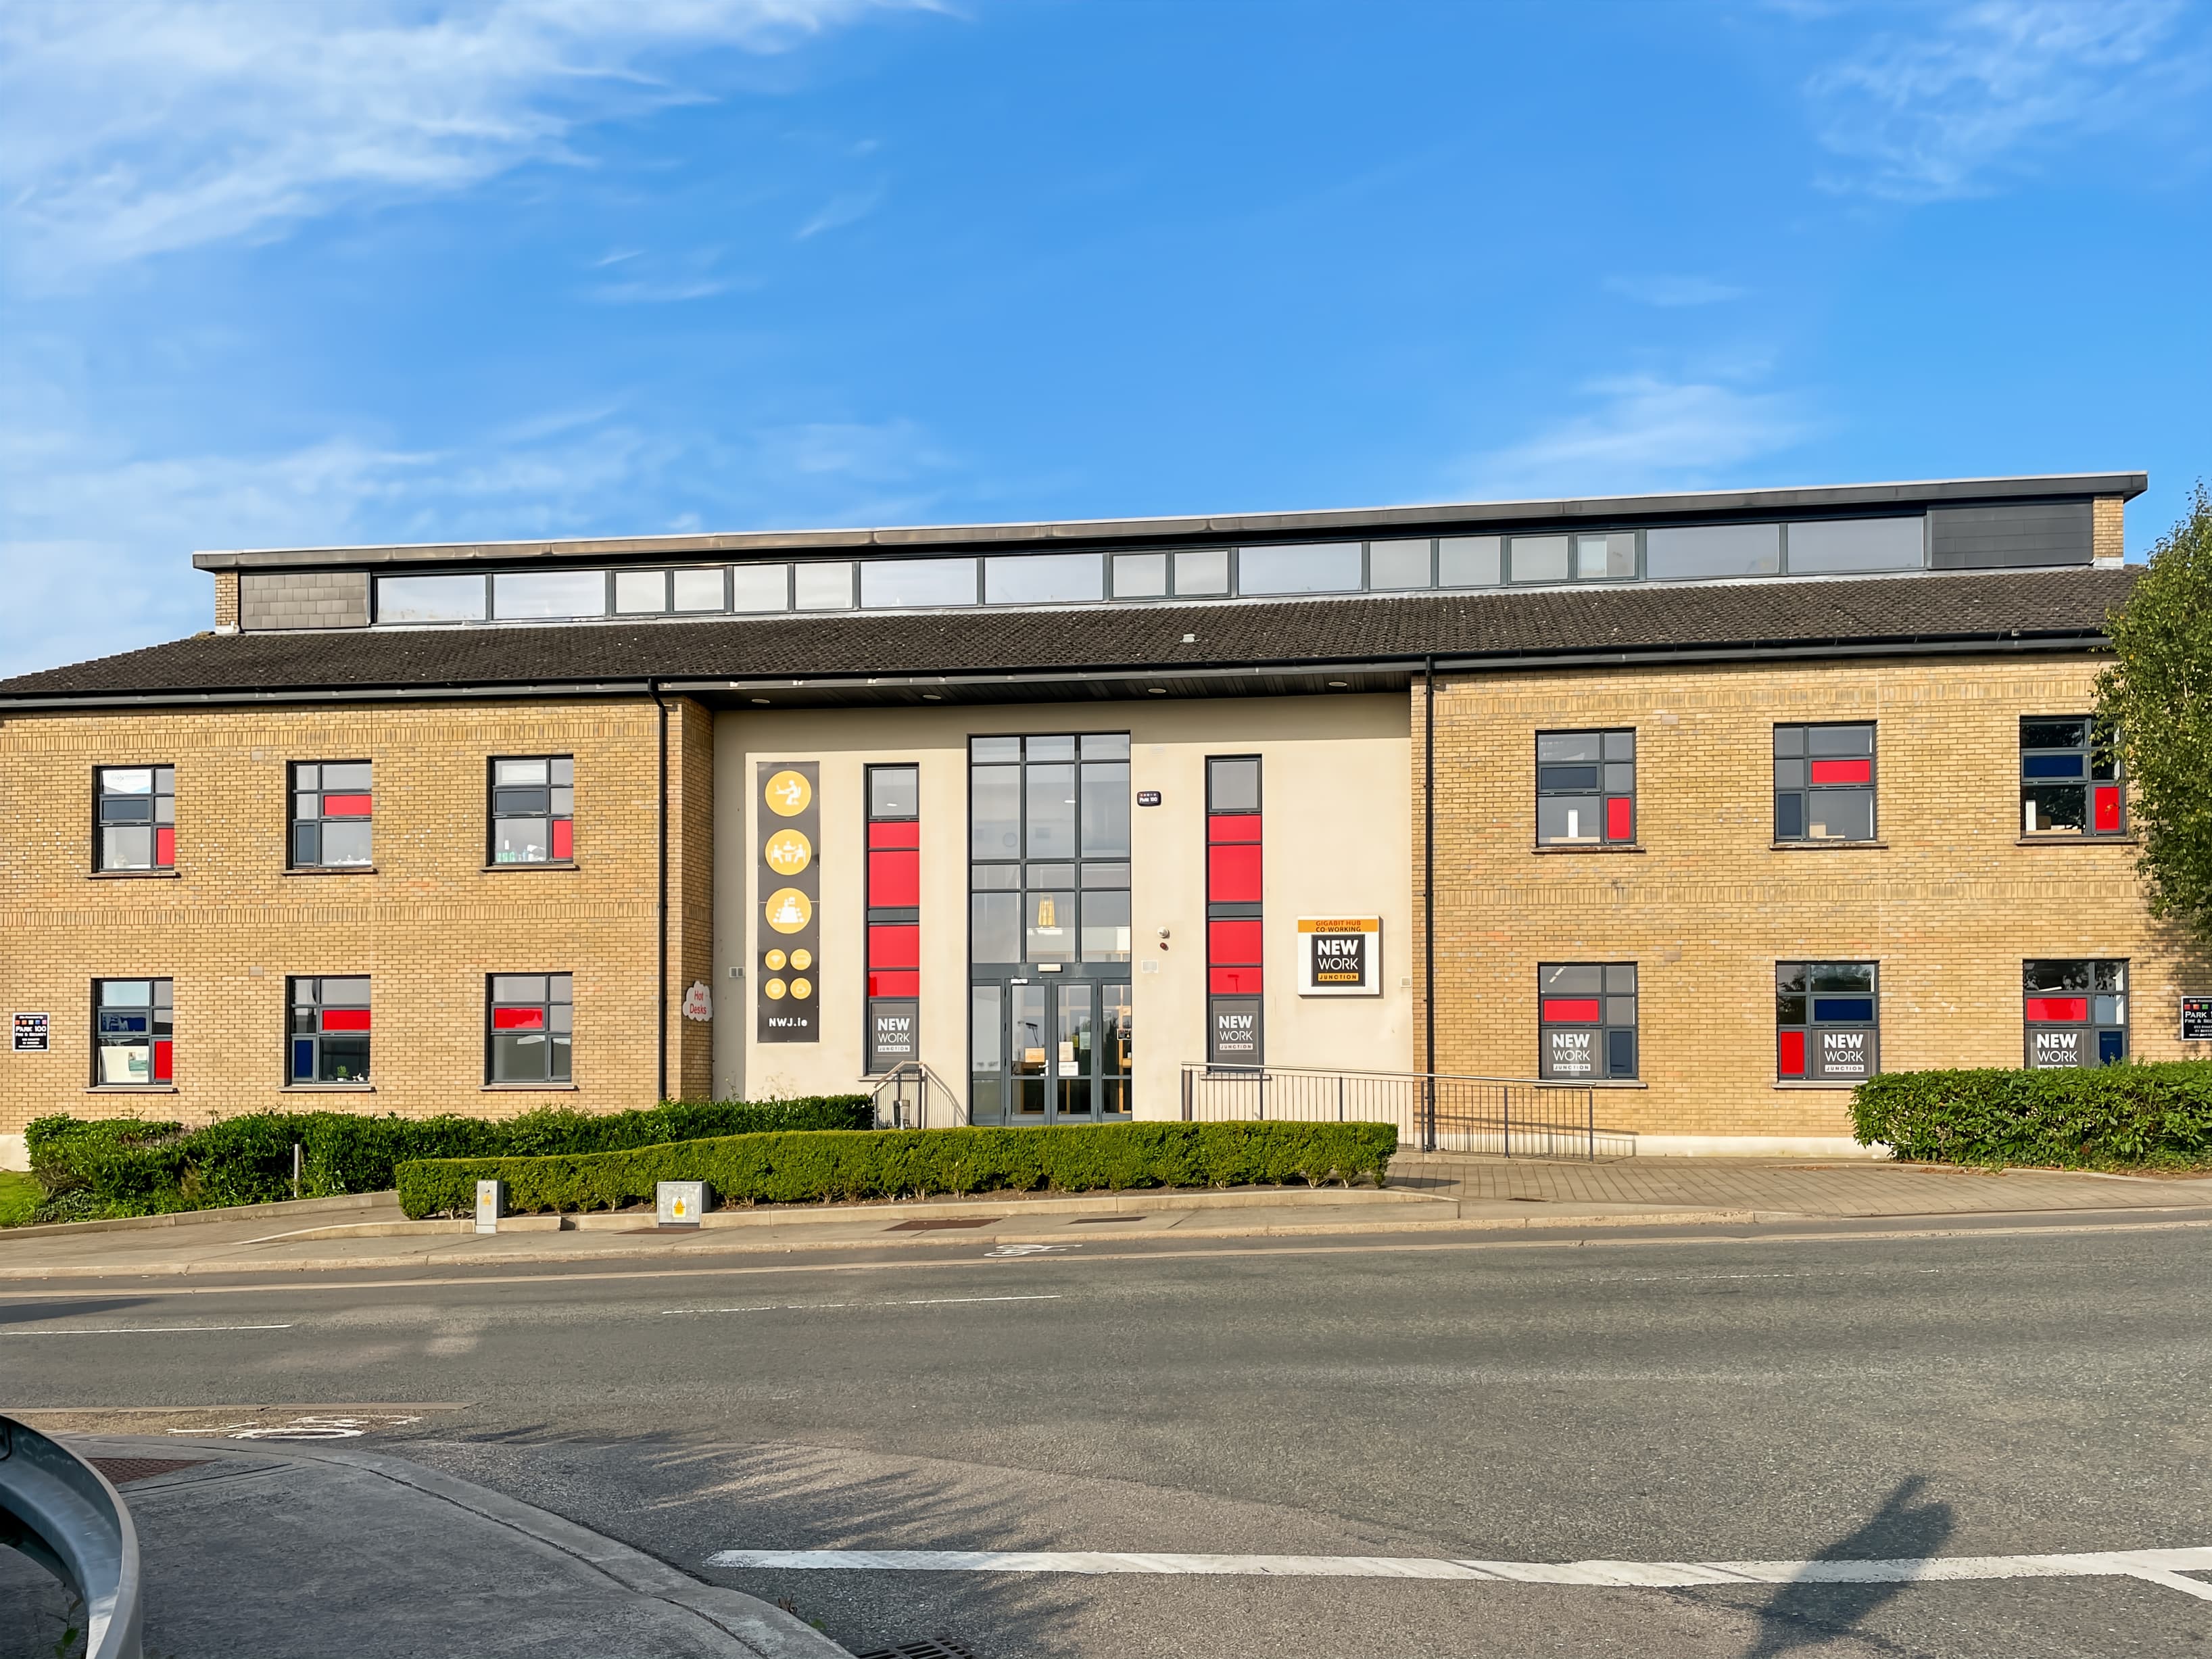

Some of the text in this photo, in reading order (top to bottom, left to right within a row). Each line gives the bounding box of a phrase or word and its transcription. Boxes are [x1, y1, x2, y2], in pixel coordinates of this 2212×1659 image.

[1318, 939, 1359, 955] NEW
[1318, 957, 1359, 970] WORK
[694, 990, 704, 1001] Hot
[690, 1003, 706, 1015] Desks
[769, 1017, 808, 1027] NWJ.ie
[877, 1017, 910, 1031] NEW
[1219, 1015, 1253, 1028] NEW
[877, 1032, 910, 1043] WORK
[1219, 1030, 1253, 1041] WORK
[1552, 1033, 1591, 1048] NEW
[1824, 1034, 1864, 1049] NEW
[2037, 1034, 2077, 1049] NEW
[1553, 1050, 1591, 1061] WORK
[1825, 1051, 1864, 1062] WORK
[2037, 1051, 2077, 1062] WORK
